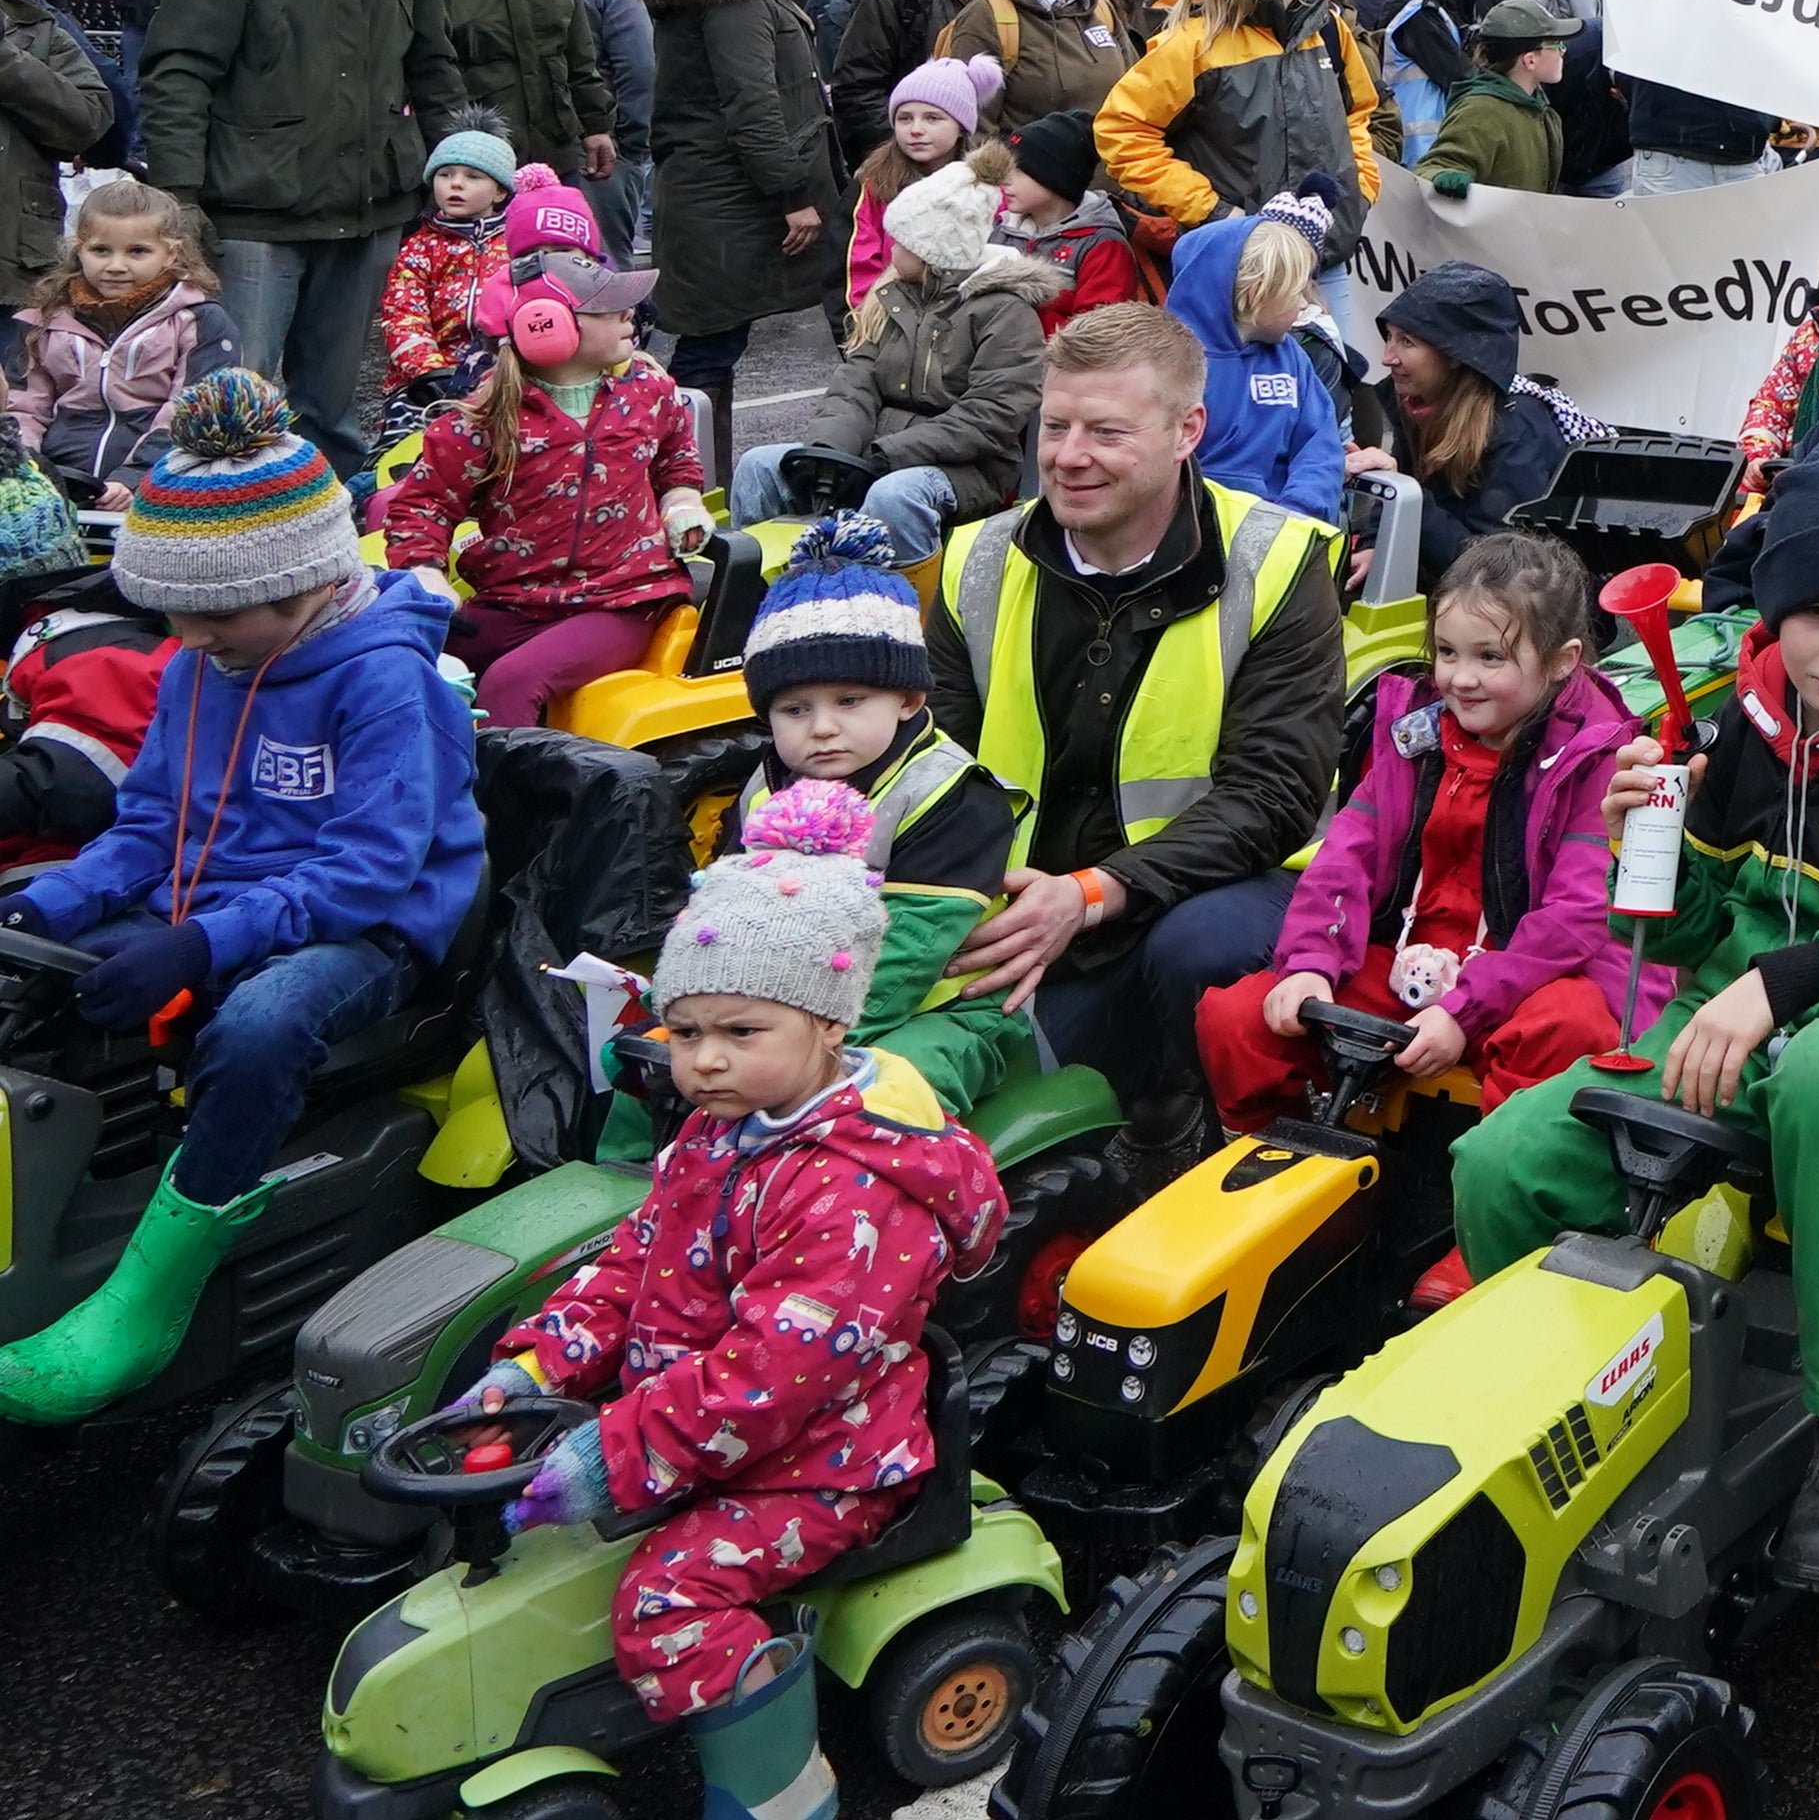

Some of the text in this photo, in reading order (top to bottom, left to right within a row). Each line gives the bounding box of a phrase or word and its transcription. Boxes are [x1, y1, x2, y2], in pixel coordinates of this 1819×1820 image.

[546, 212, 585, 235] BBF
[528, 319, 553, 333] kid
[713, 656, 743, 670] JCB
[259, 749, 322, 788] BBF
[1086, 1332, 1117, 1352] JCB
[1601, 1337, 1650, 1394] CLAAS
